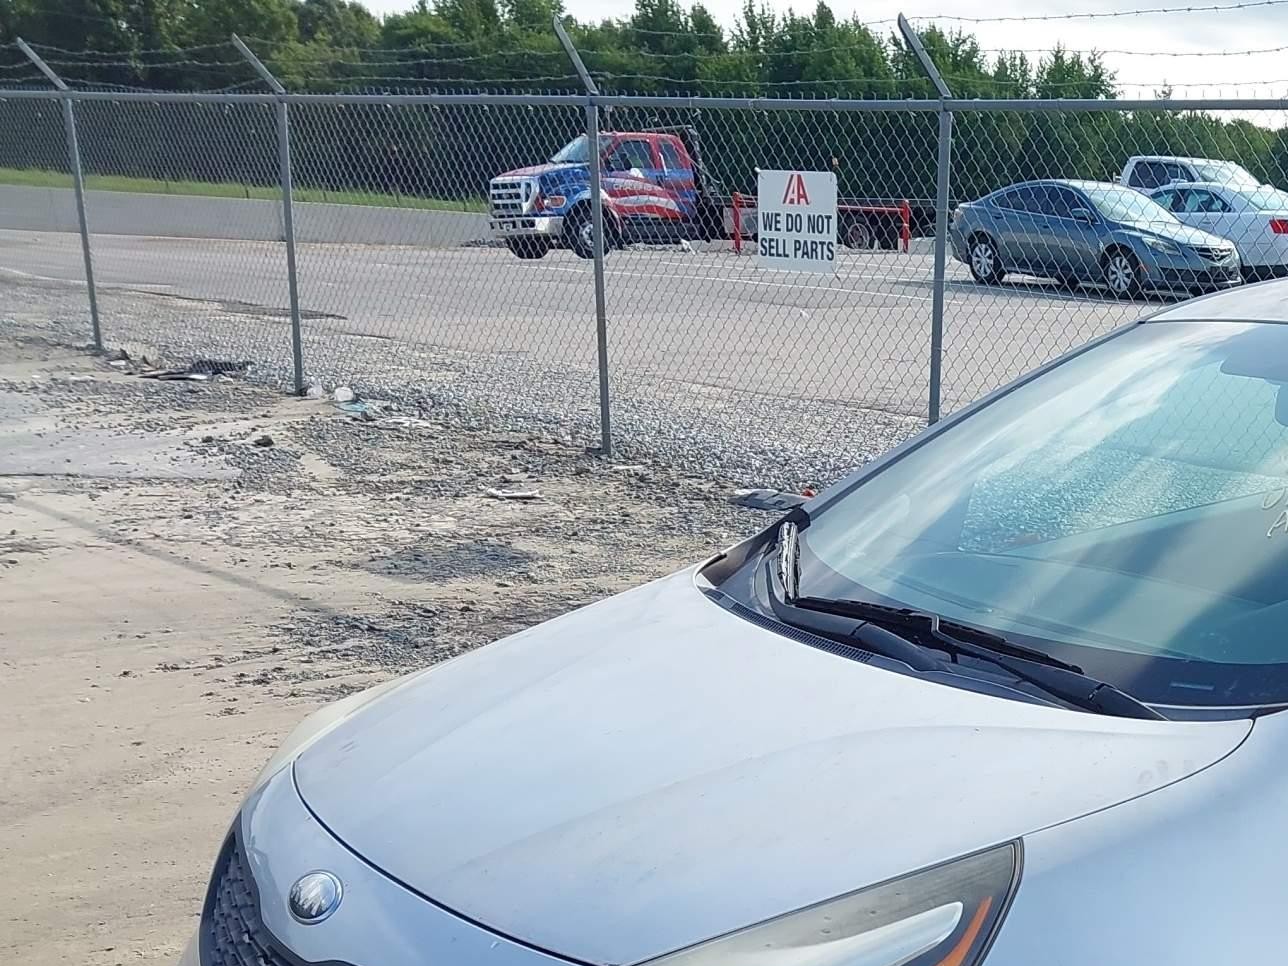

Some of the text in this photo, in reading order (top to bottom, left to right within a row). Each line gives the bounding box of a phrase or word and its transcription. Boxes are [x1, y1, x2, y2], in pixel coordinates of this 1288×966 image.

[762, 212, 832, 234] WE DO NOT
[760, 237, 834, 261] SELL PARTS
